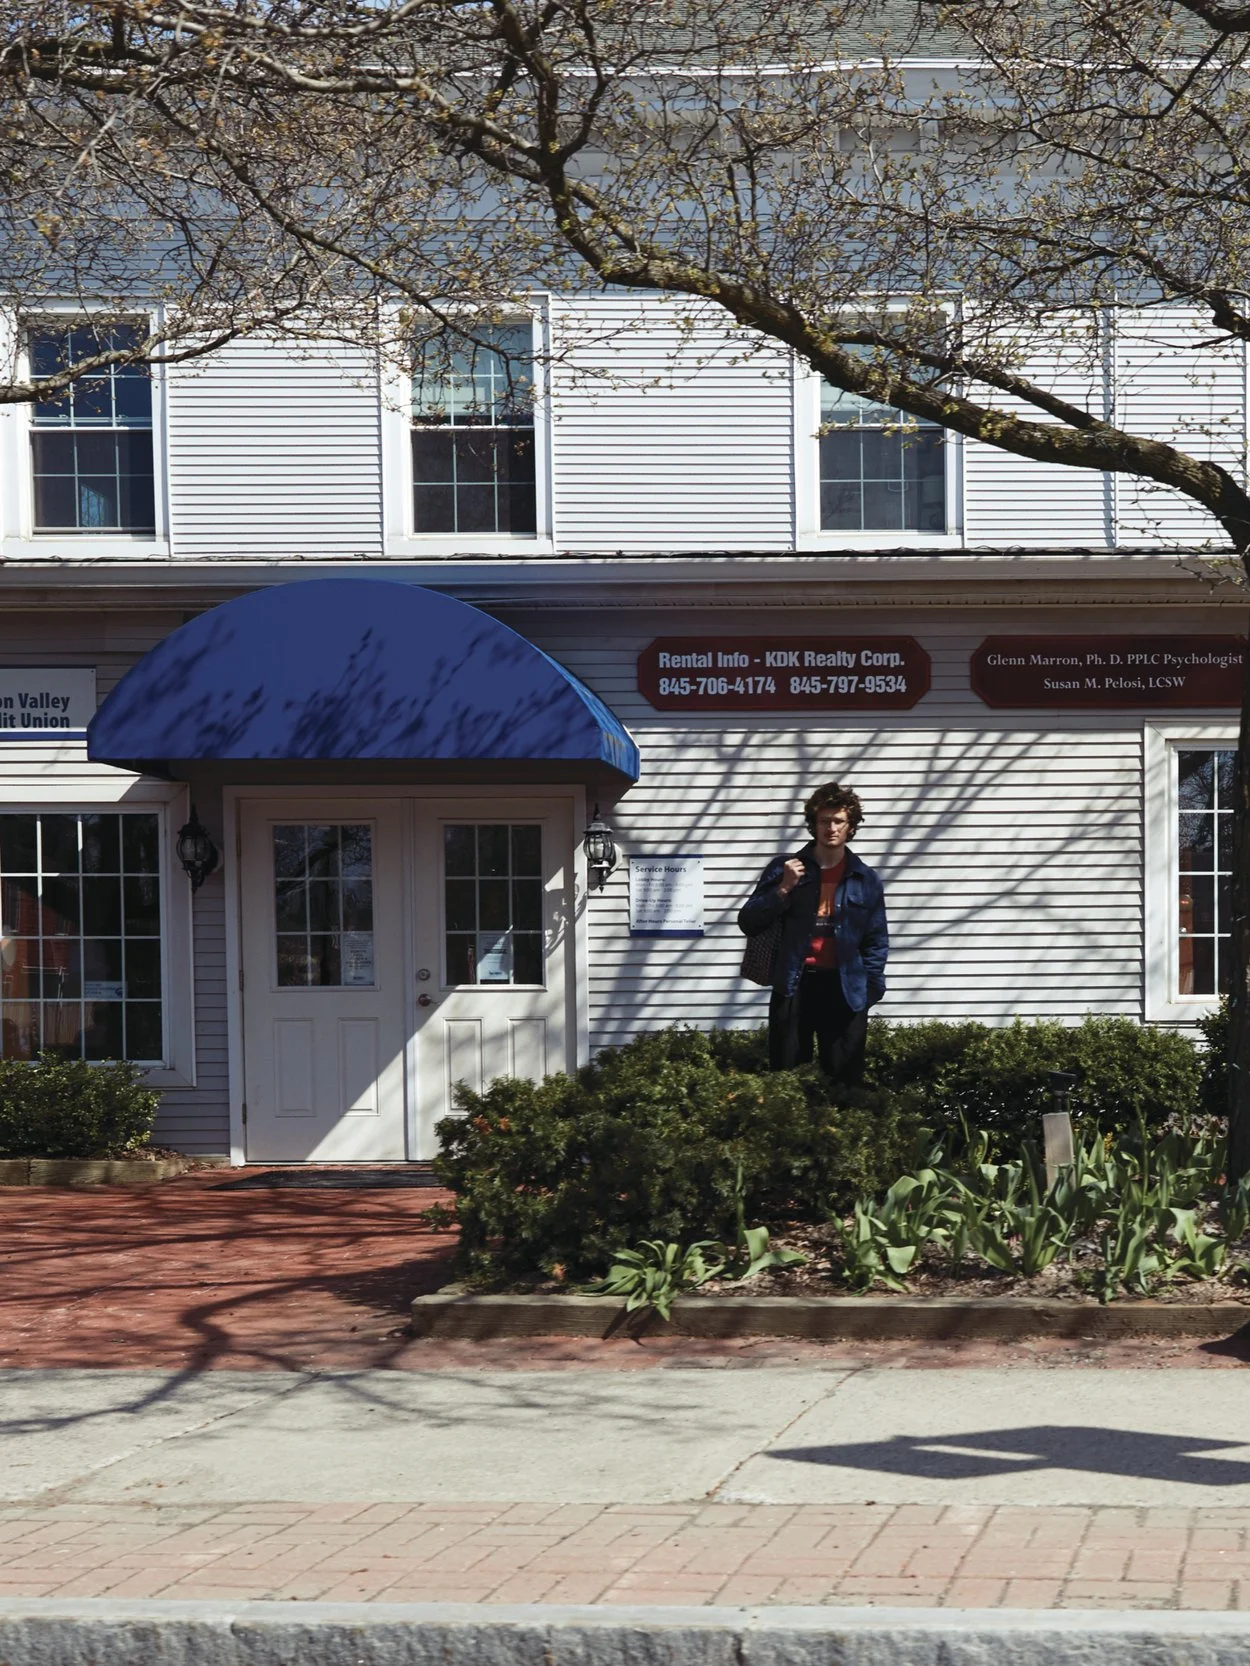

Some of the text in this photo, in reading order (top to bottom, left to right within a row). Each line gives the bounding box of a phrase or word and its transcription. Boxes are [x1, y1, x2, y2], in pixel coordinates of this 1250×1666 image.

[658, 652, 712, 668] Rental
[717, 652, 749, 667] Info
[765, 651, 800, 667] KDK
[804, 651, 856, 668] Realty
[860, 650, 905, 668] Corp.
[987, 653, 1243, 669] Glenn Marron, Ph. D. PPLC Psychologist
[658, 675, 907, 695] 845-706-4174 845-797-9534
[1043, 676, 1186, 690] Susan M. Pelosi, LCSW
[18, 692, 70, 713] Valley
[21, 712, 70, 728] Union
[635, 865, 687, 873] Service Hours
